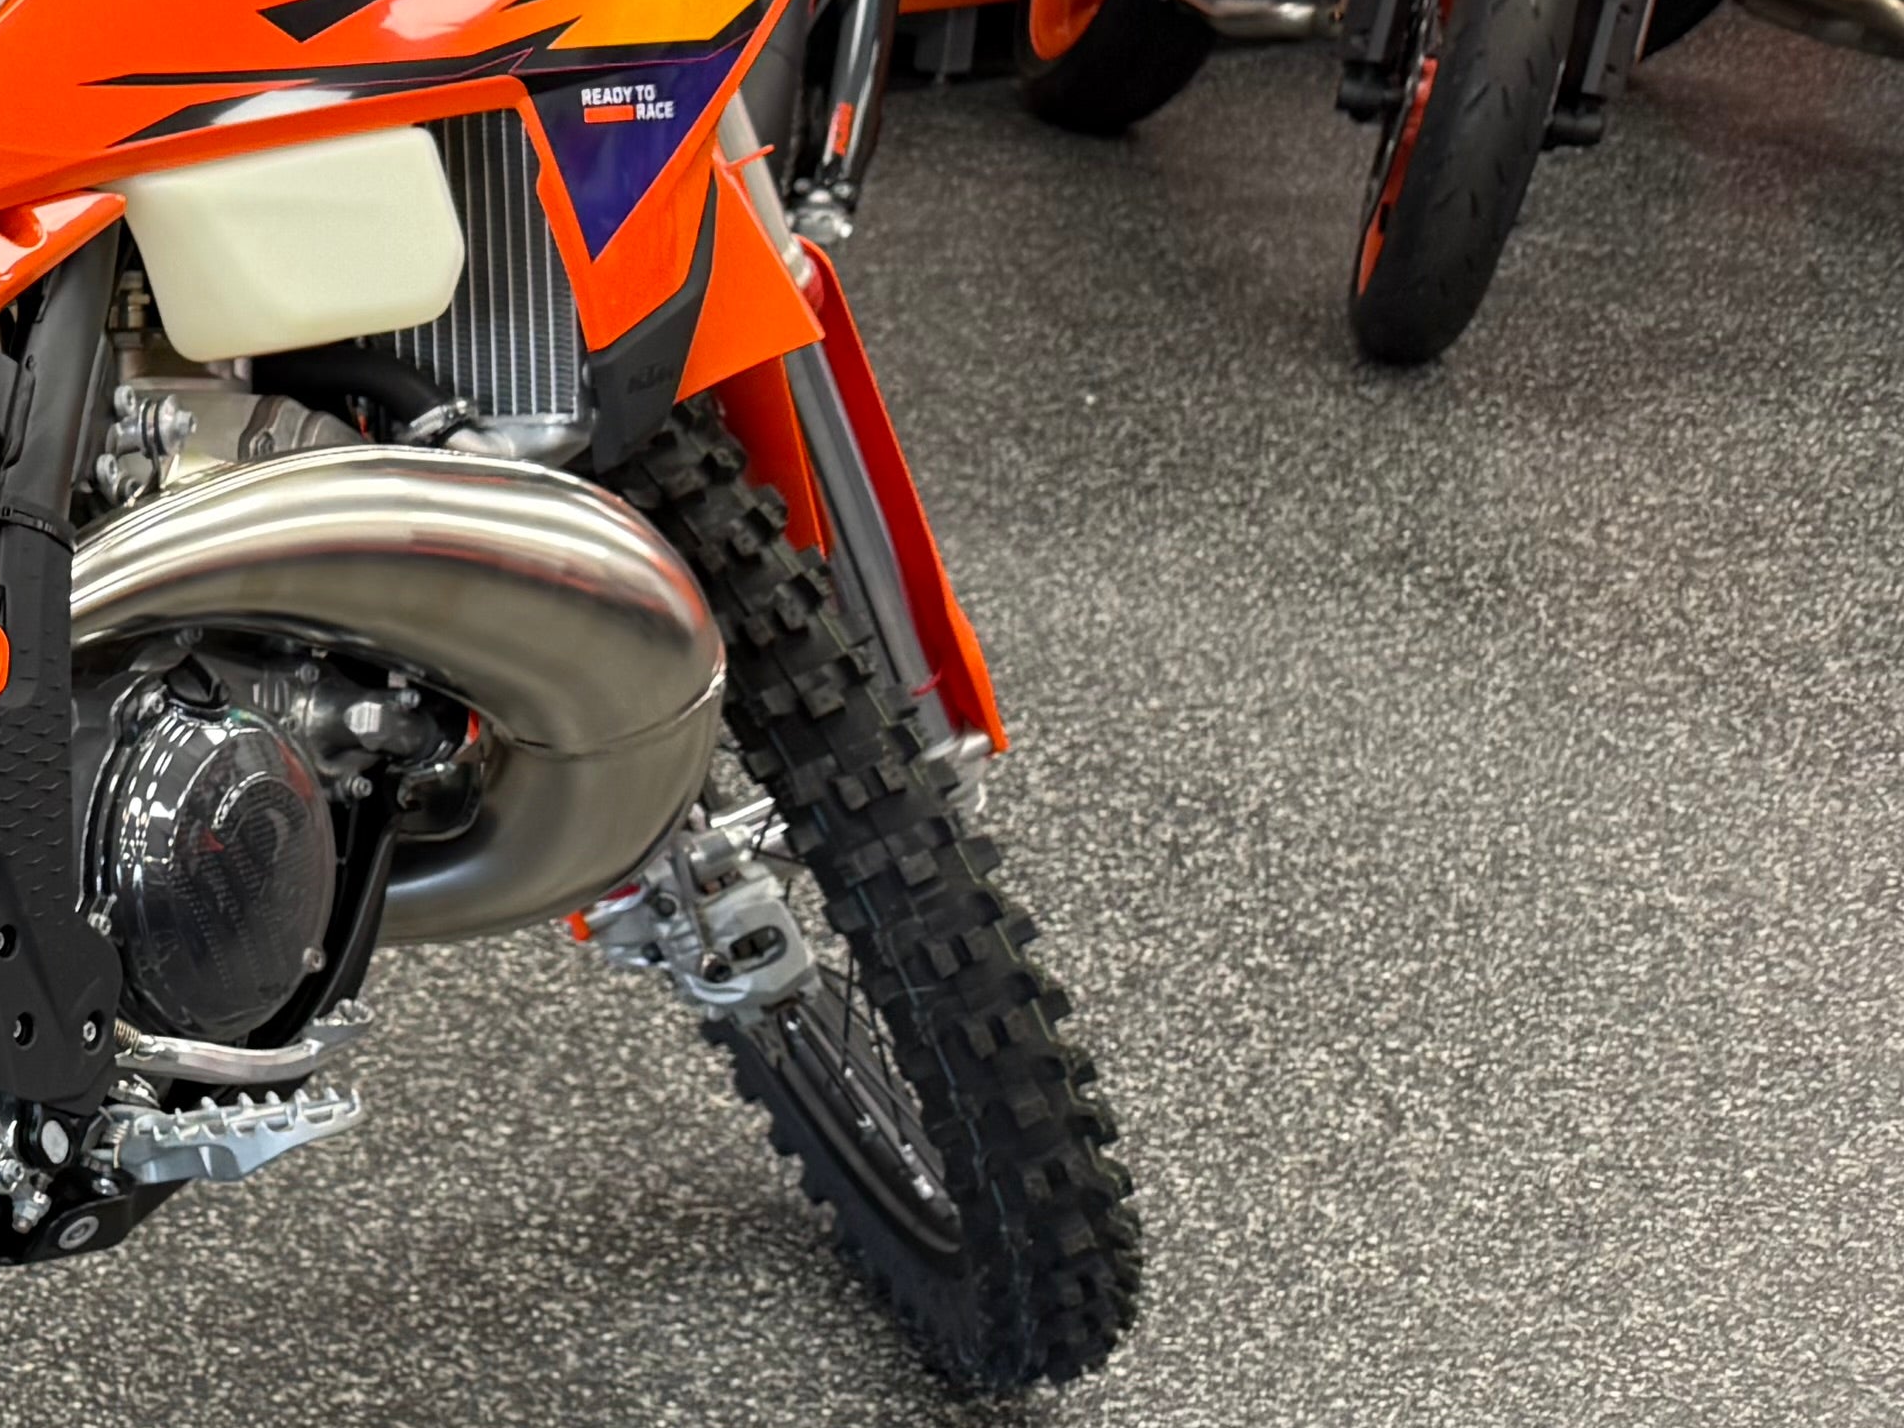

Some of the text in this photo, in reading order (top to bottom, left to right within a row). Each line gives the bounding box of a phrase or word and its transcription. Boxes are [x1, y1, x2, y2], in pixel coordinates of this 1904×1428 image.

[581, 84, 656, 106] READY TO
[636, 101, 675, 121] RACE
